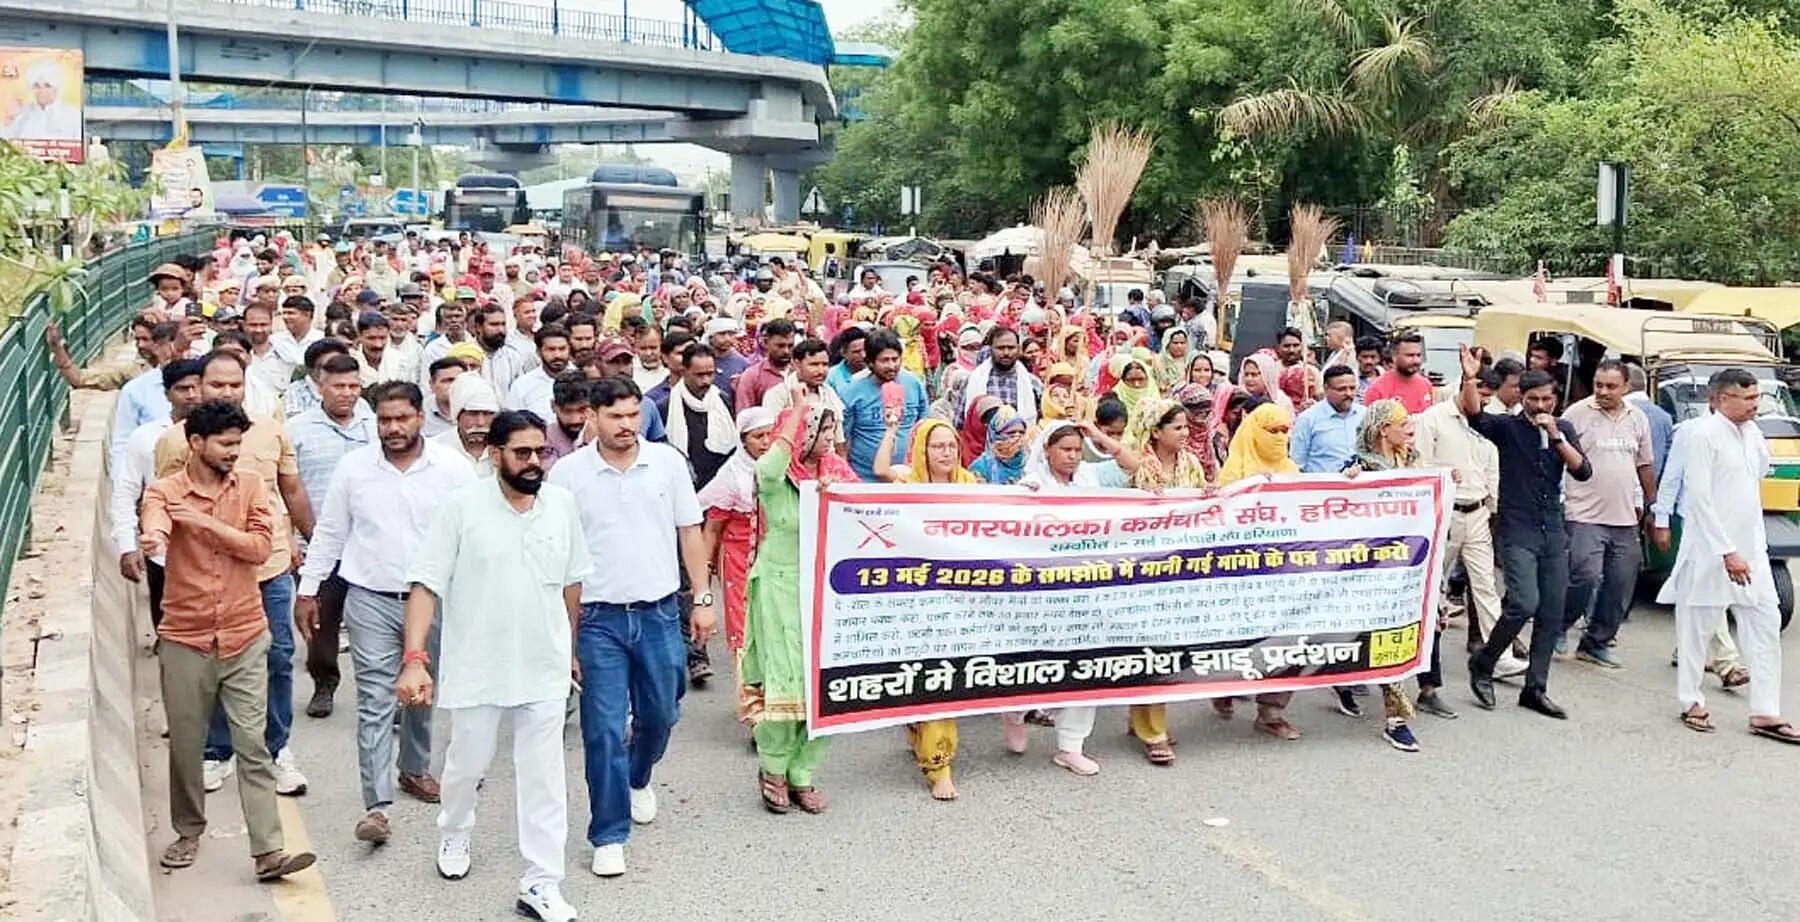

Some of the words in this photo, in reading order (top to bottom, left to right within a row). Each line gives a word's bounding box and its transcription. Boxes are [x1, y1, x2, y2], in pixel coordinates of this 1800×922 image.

[922, 513, 1112, 537] नगरपालिका
[1120, 505, 1225, 533] कर्मचारी
[1232, 501, 1287, 524] संघ,
[1298, 497, 1419, 523] हरियाणा
[1243, 526, 1297, 541] हरियाणा
[857, 567, 889, 587] 13
[895, 562, 932, 587] मई
[1010, 563, 1034, 585] के
[1140, 554, 1182, 577] मानी
[1186, 551, 1214, 575] गई
[1264, 547, 1284, 568] के
[1288, 549, 1318, 567] पत्र
[1324, 543, 1370, 565] जारी
[1372, 540, 1410, 561] करो
[1390, 632, 1403, 645] व
[1408, 627, 1416, 640] 2
[828, 661, 924, 702] शहरों
[964, 656, 1070, 689] विशाल
[1072, 647, 1183, 681] आक्रोश
